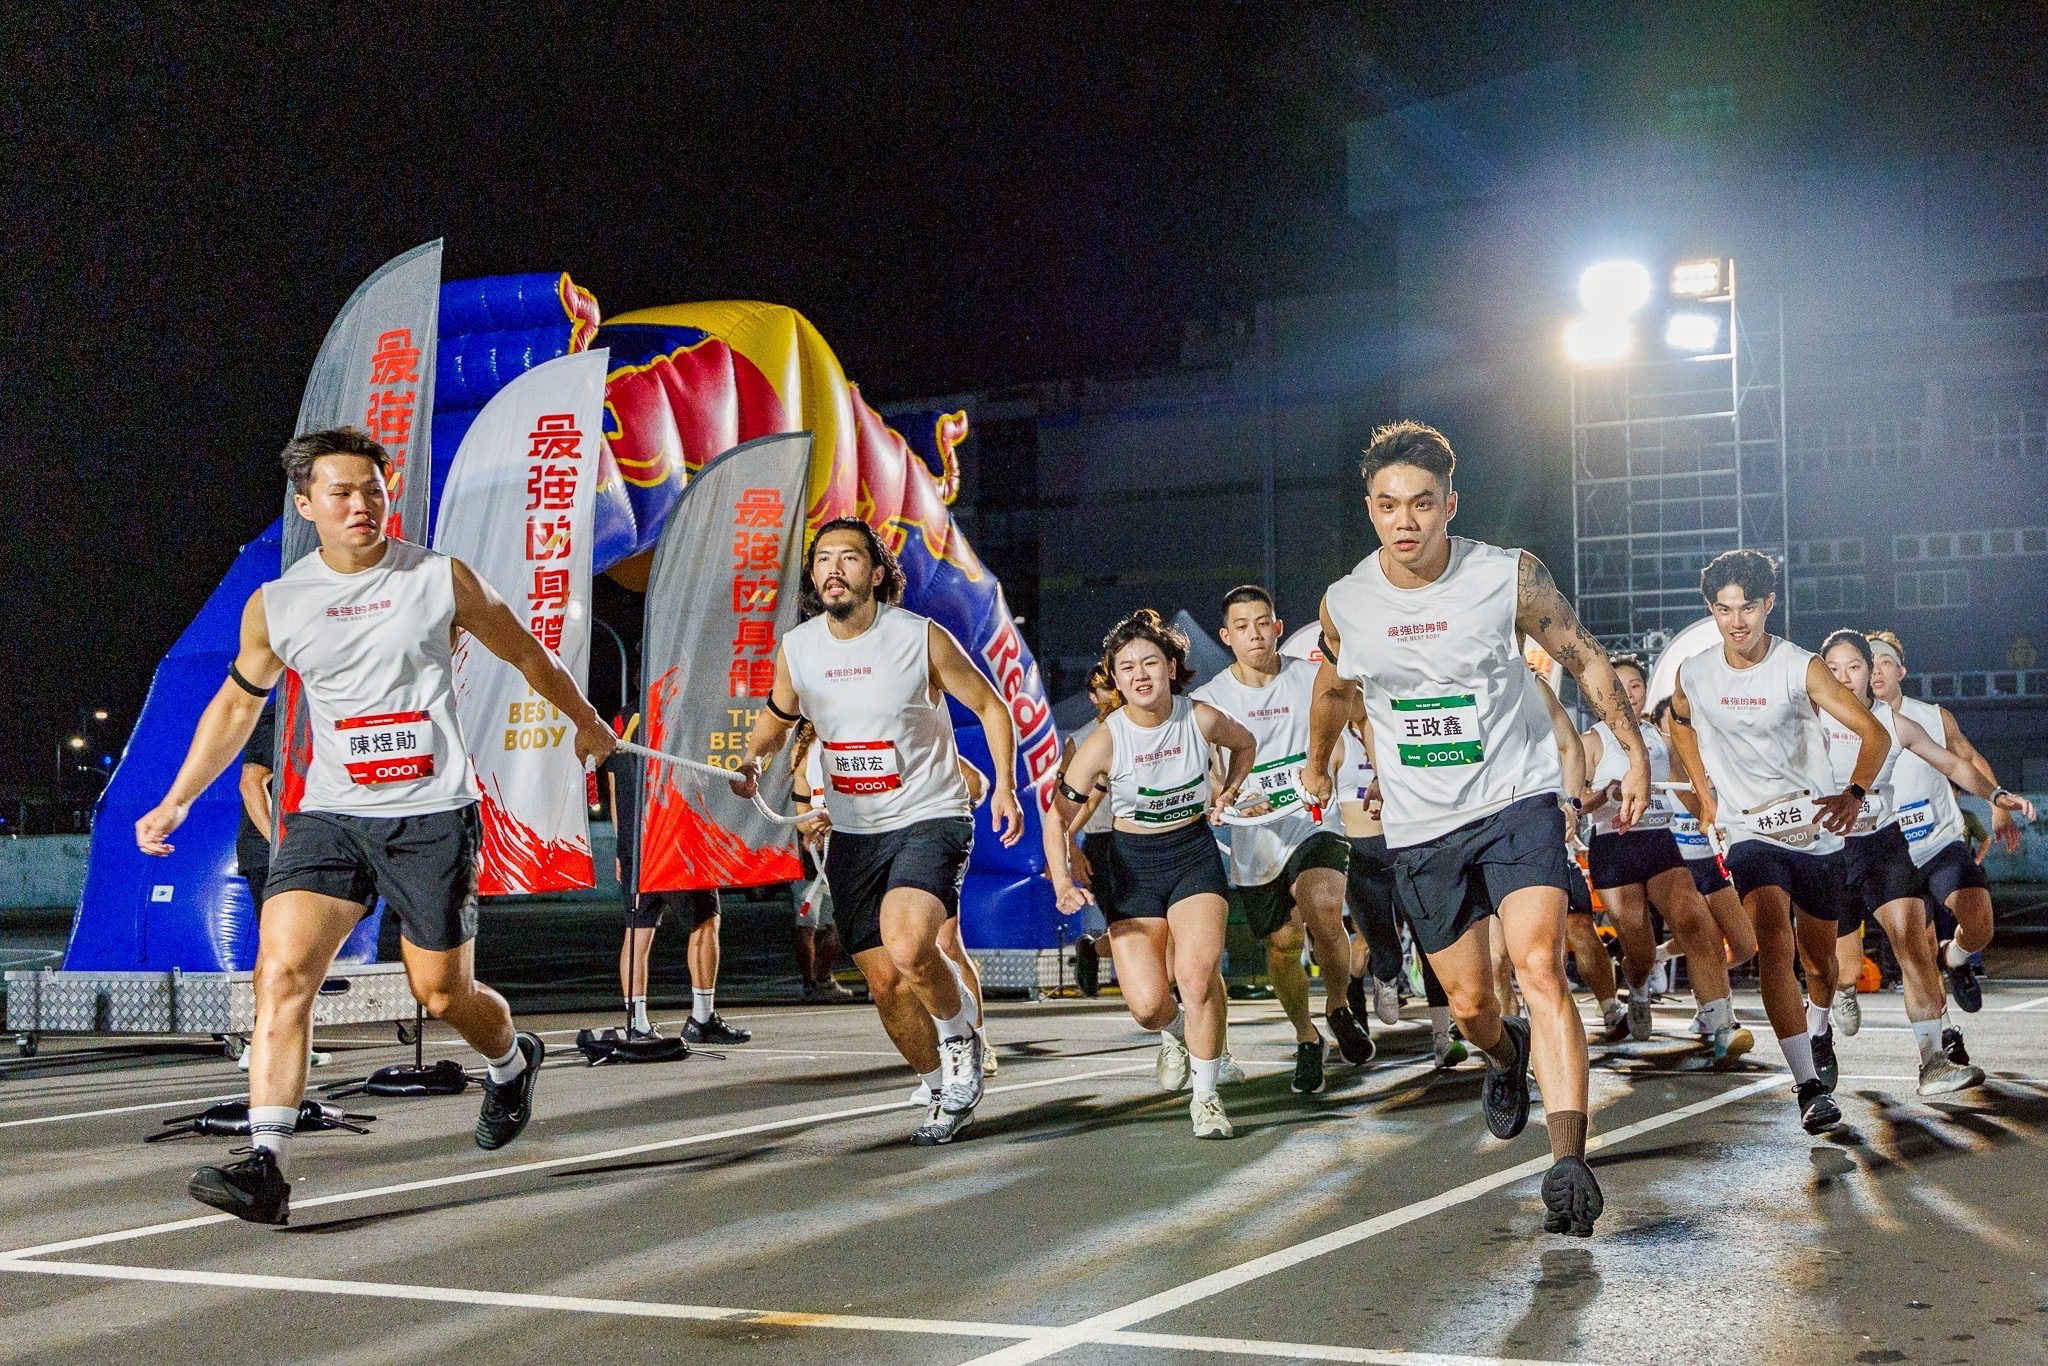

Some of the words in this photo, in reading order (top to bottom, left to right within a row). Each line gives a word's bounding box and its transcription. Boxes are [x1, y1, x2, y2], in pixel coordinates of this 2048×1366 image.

[729, 487, 785, 698] 最強的身體
[1387, 621, 1448, 637] 最強的身體
[986, 622, 1049, 739] Red
[727, 709, 760, 727] TH
[1404, 715, 1463, 737] 王政鑫
[350, 730, 417, 756] 陳煜勛
[504, 726, 567, 751] BODY
[710, 731, 753, 750] BE
[835, 756, 884, 772] 施叡宏
[1427, 750, 1464, 762] 0001
[375, 764, 418, 778] 0001
[1259, 769, 1292, 789] 黃書
[855, 781, 887, 791] 0001
[1163, 808, 1193, 821] 0001
[1757, 807, 1802, 830] 林汶台
[1780, 832, 1808, 843] 0001
[1904, 829, 1927, 841] 0001
